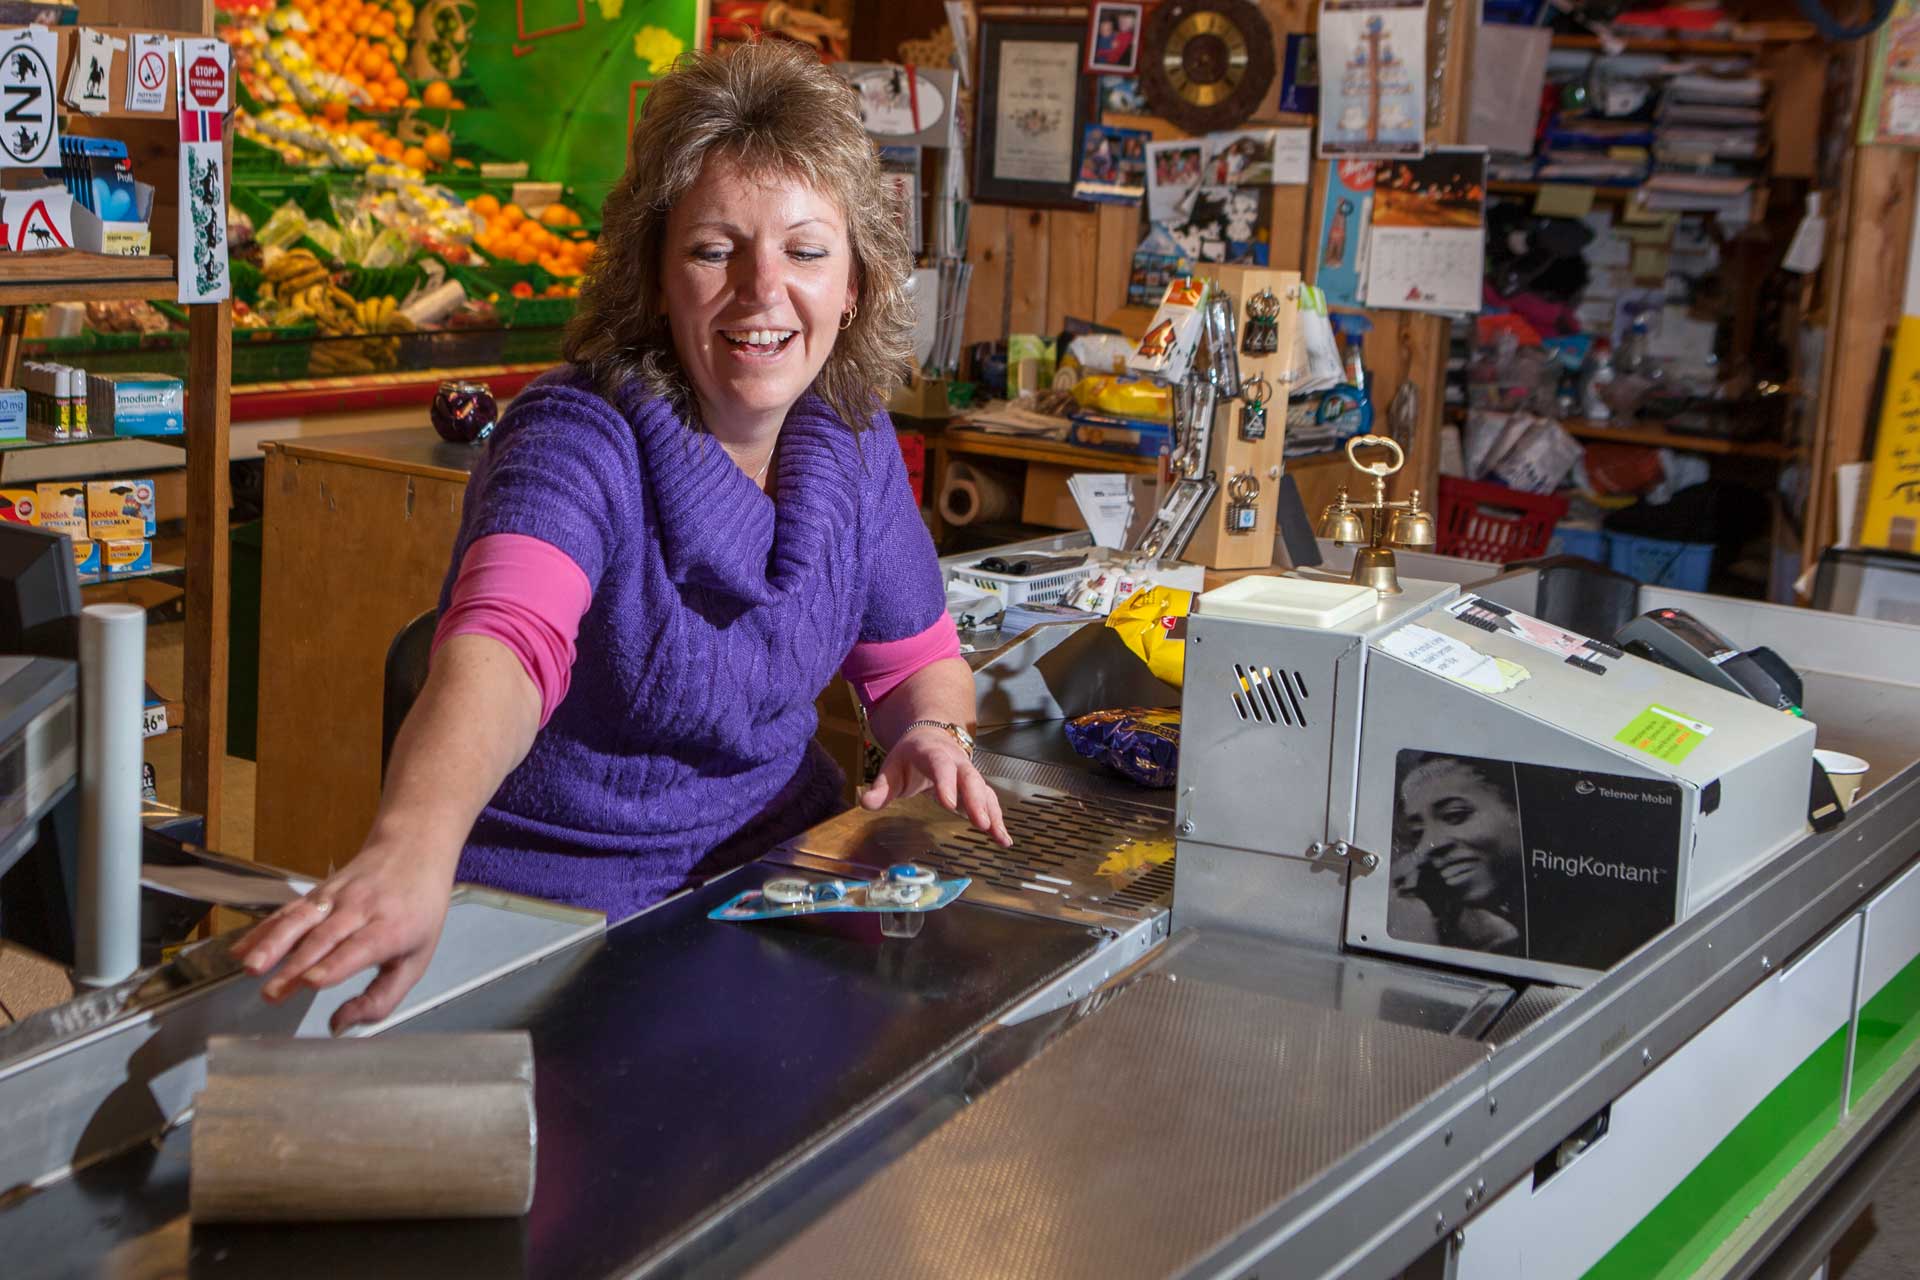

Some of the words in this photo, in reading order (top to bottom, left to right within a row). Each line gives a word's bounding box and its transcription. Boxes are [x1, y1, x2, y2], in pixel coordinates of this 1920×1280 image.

[195, 65, 218, 78] STOPP
[118, 393, 157, 404] Imodium
[10, 402, 24, 412] mg
[40, 511, 69, 519] Kodak
[91, 509, 118, 518] Kodak
[1600, 787, 1639, 800] Telenor
[1641, 792, 1672, 805] Mobil
[1531, 849, 1659, 884] RingKontant
